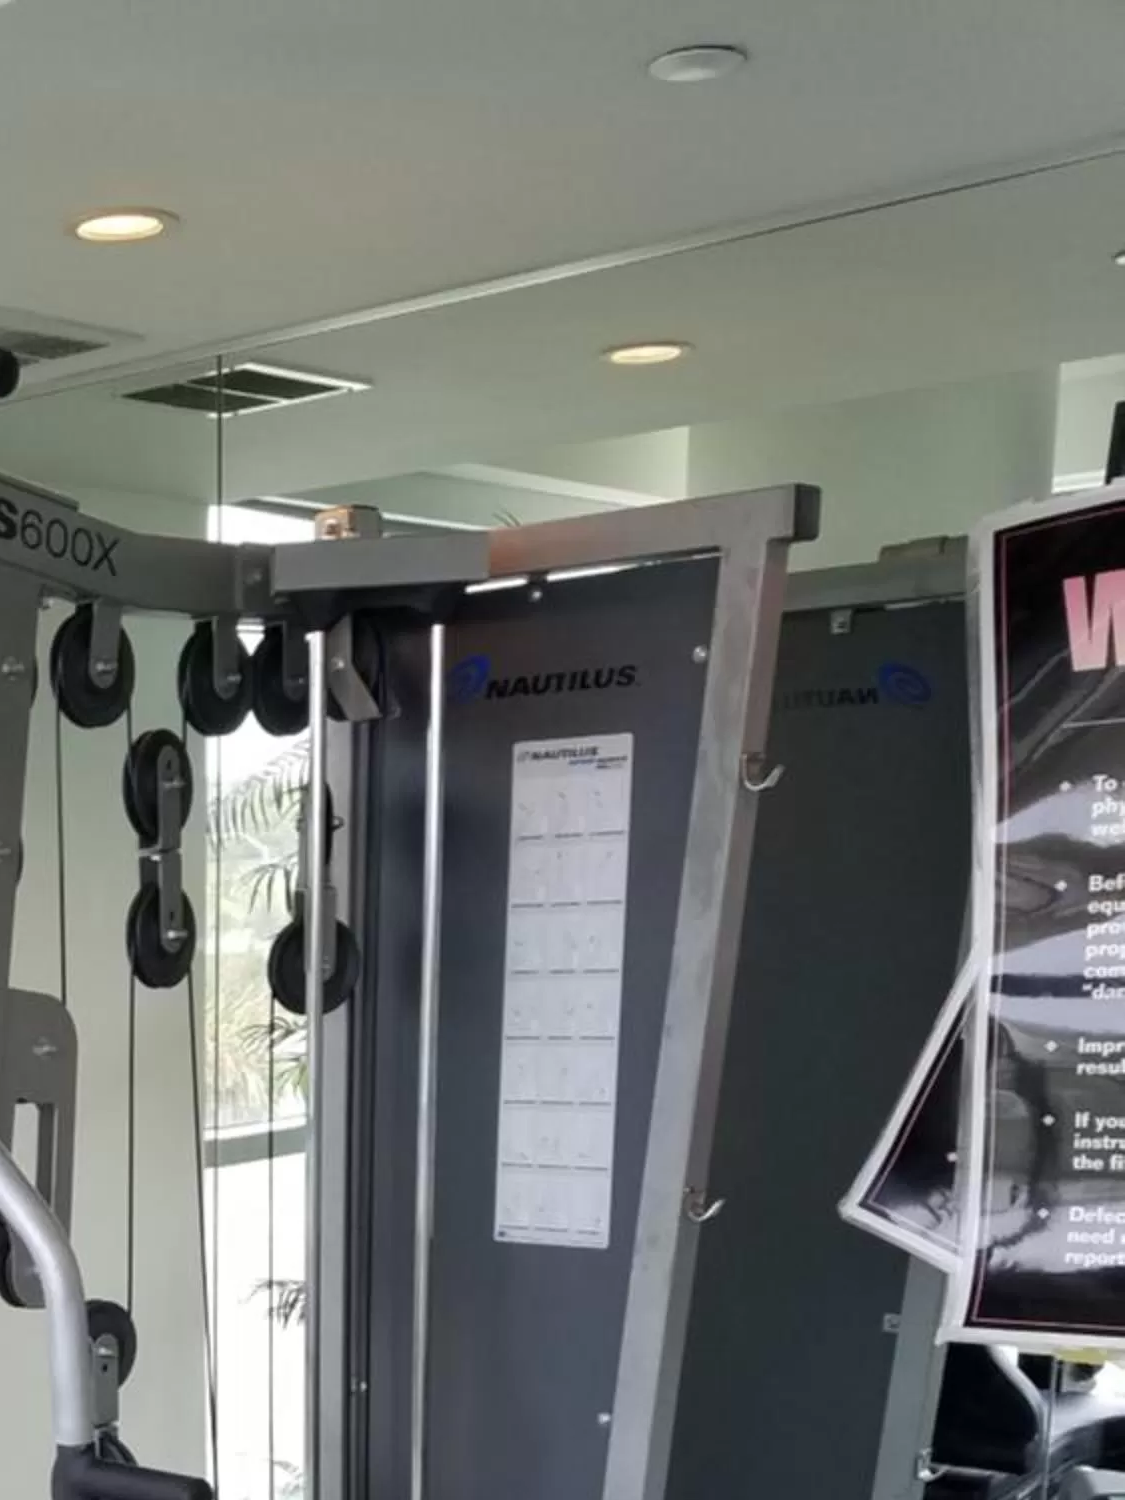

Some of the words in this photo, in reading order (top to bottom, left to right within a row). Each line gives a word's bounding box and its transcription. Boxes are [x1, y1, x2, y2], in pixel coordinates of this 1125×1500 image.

[486, 664, 639, 701] NAUTILUS
[1092, 774, 1118, 793] To
[1074, 1110, 1090, 1129] If
[1072, 1154, 1104, 1171] the
[1066, 1227, 1116, 1245] need
